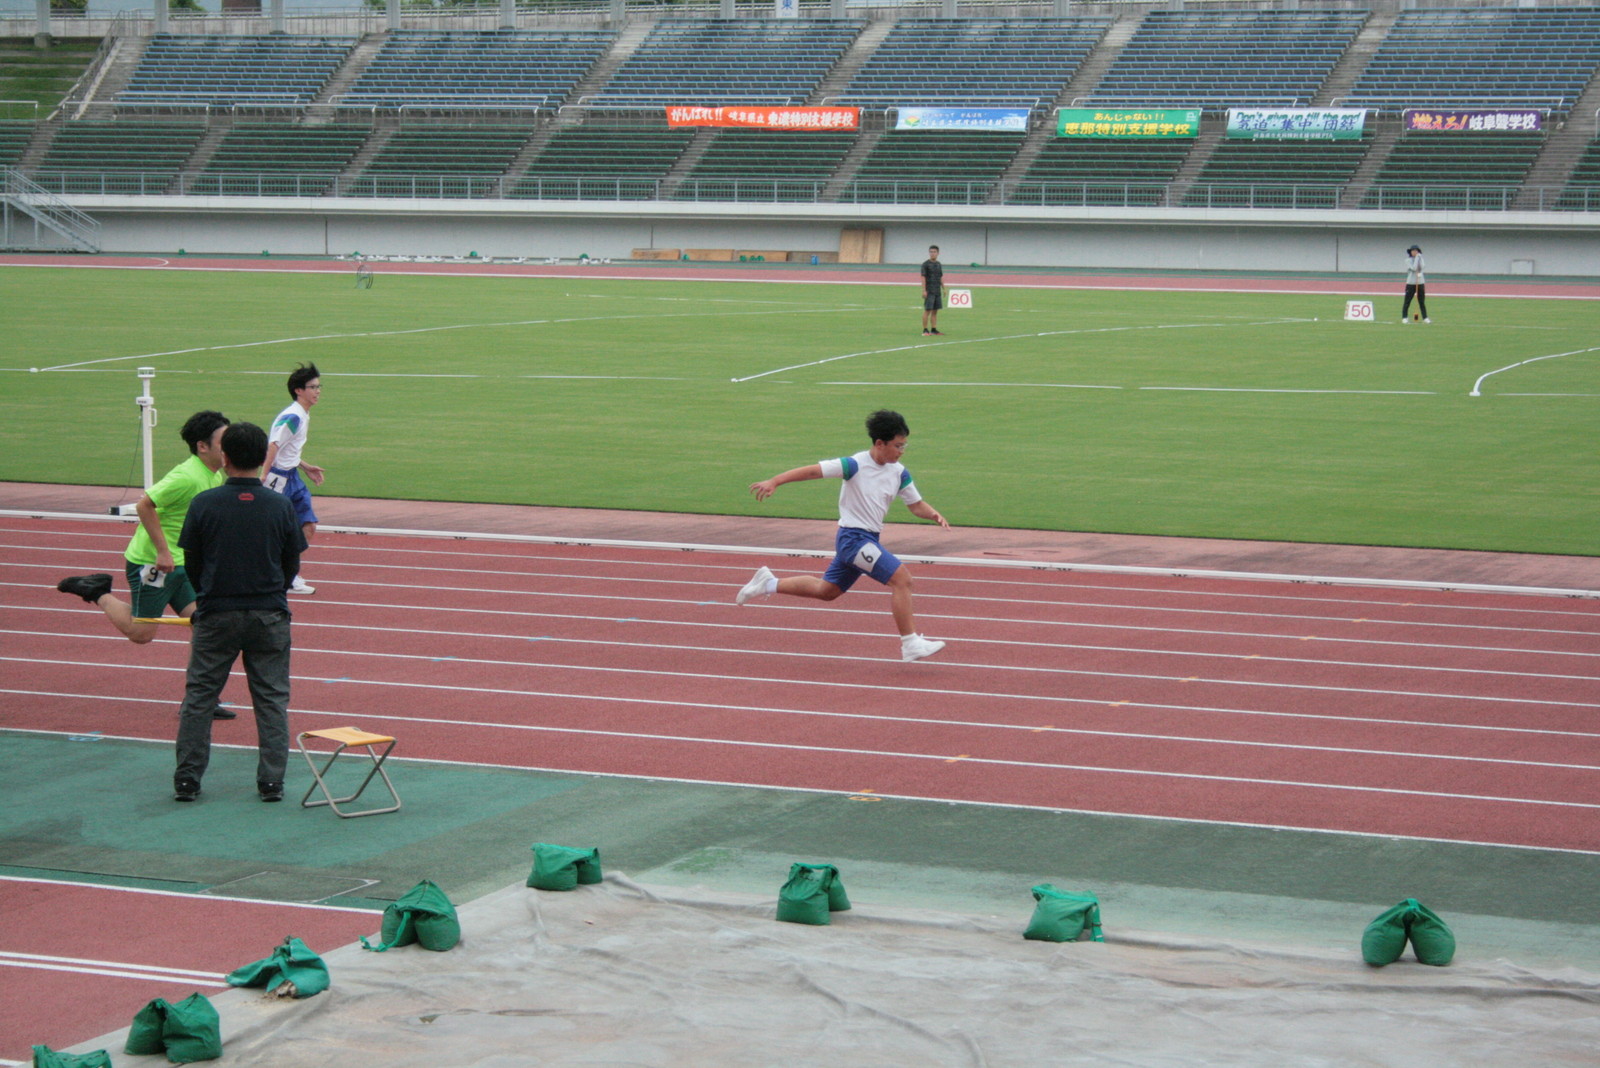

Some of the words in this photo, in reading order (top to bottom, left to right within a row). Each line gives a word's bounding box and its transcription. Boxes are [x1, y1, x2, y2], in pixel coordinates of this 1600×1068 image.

[1065, 122, 1191, 136] 恵那特別支援学校
[950, 293, 969, 305] 60
[1352, 304, 1371, 318] 50
[269, 477, 279, 490] 4
[861, 551, 874, 563] 6
[147, 567, 159, 583] 9
